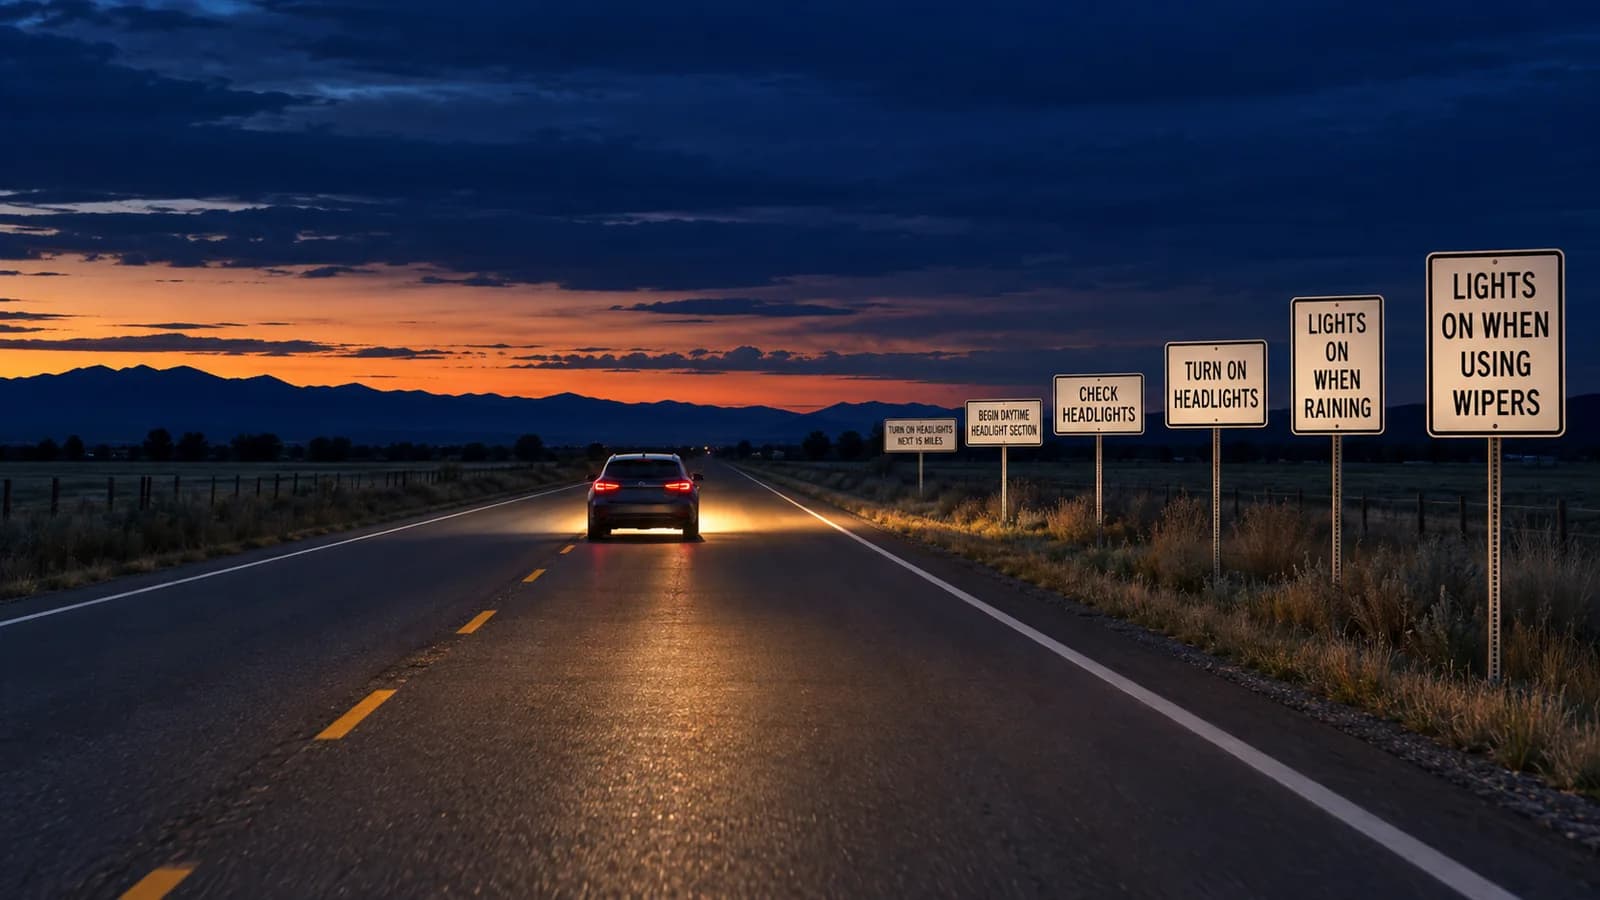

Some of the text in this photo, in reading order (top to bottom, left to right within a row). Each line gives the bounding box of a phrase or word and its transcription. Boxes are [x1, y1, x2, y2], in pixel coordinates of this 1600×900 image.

[1453, 271, 1536, 300] LIGHTS
[1308, 312, 1366, 335] LIGHTS
[1441, 311, 1549, 339] ON WHEN
[1325, 341, 1348, 362] ON
[1185, 360, 1247, 381] TURN ON
[1460, 350, 1531, 378] USING
[1313, 369, 1361, 390] WHEN
[1079, 386, 1118, 402] CHECK
[1174, 388, 1259, 409] HEADLIGHTS
[1453, 389, 1540, 416] WIPERS
[978, 409, 1030, 421] BEGIN DAYTIME
[1062, 406, 1136, 422] HEADLIGHTS
[1304, 398, 1371, 419] RAINING
[888, 425, 953, 434] TURN ON HEADLIGHTS
[971, 424, 1037, 436] HEADLIGHT SECTION
[897, 437, 943, 445] NEXT 15 MILES
